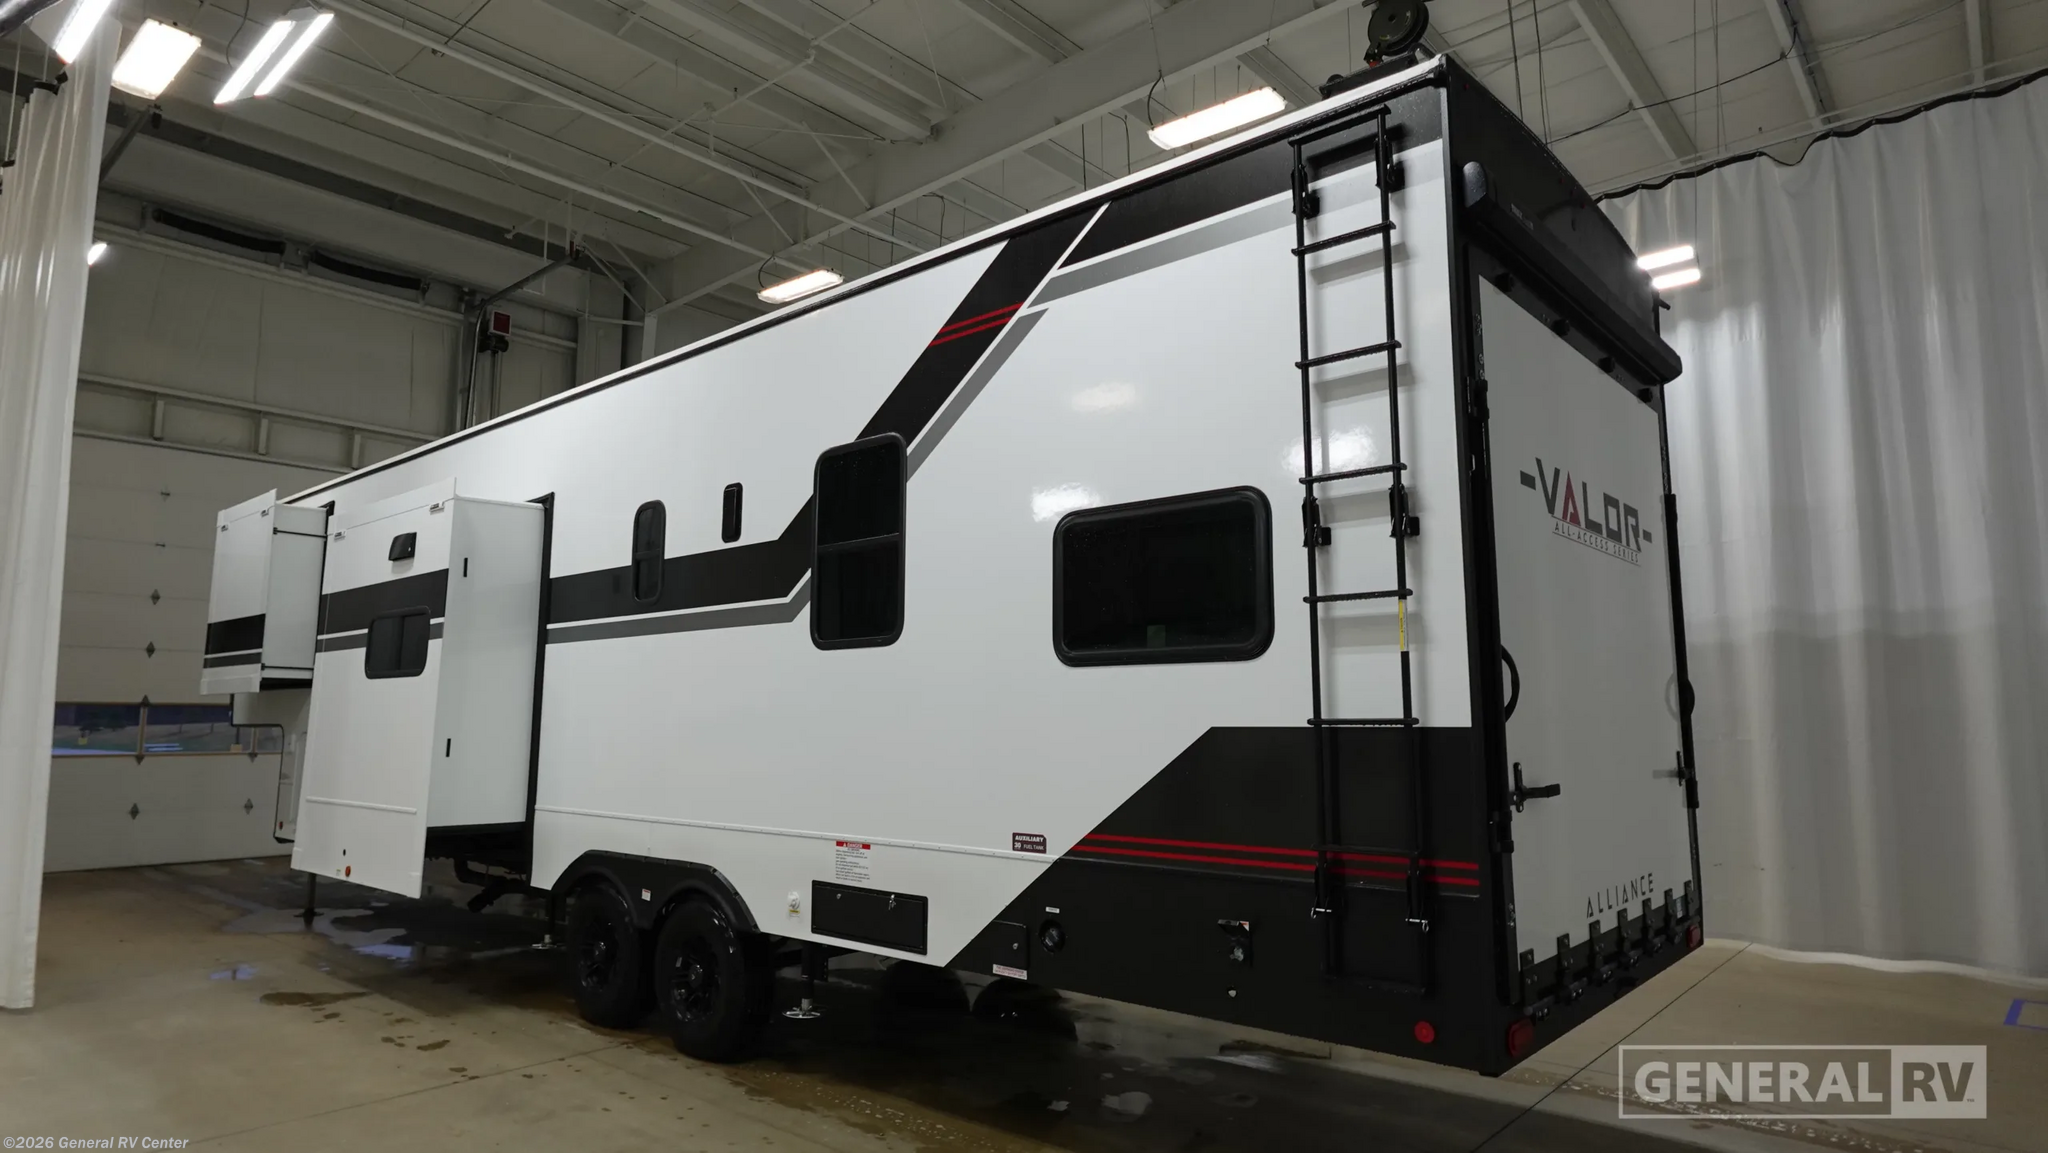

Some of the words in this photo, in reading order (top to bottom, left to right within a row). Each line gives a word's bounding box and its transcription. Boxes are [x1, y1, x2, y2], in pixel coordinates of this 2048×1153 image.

[1554, 521, 1609, 551] ALL-ACCESS
[1613, 544, 1639, 563] SERIES
[1015, 835, 1044, 843] AUXILIARY
[1586, 872, 1654, 918] ALLIANCE
